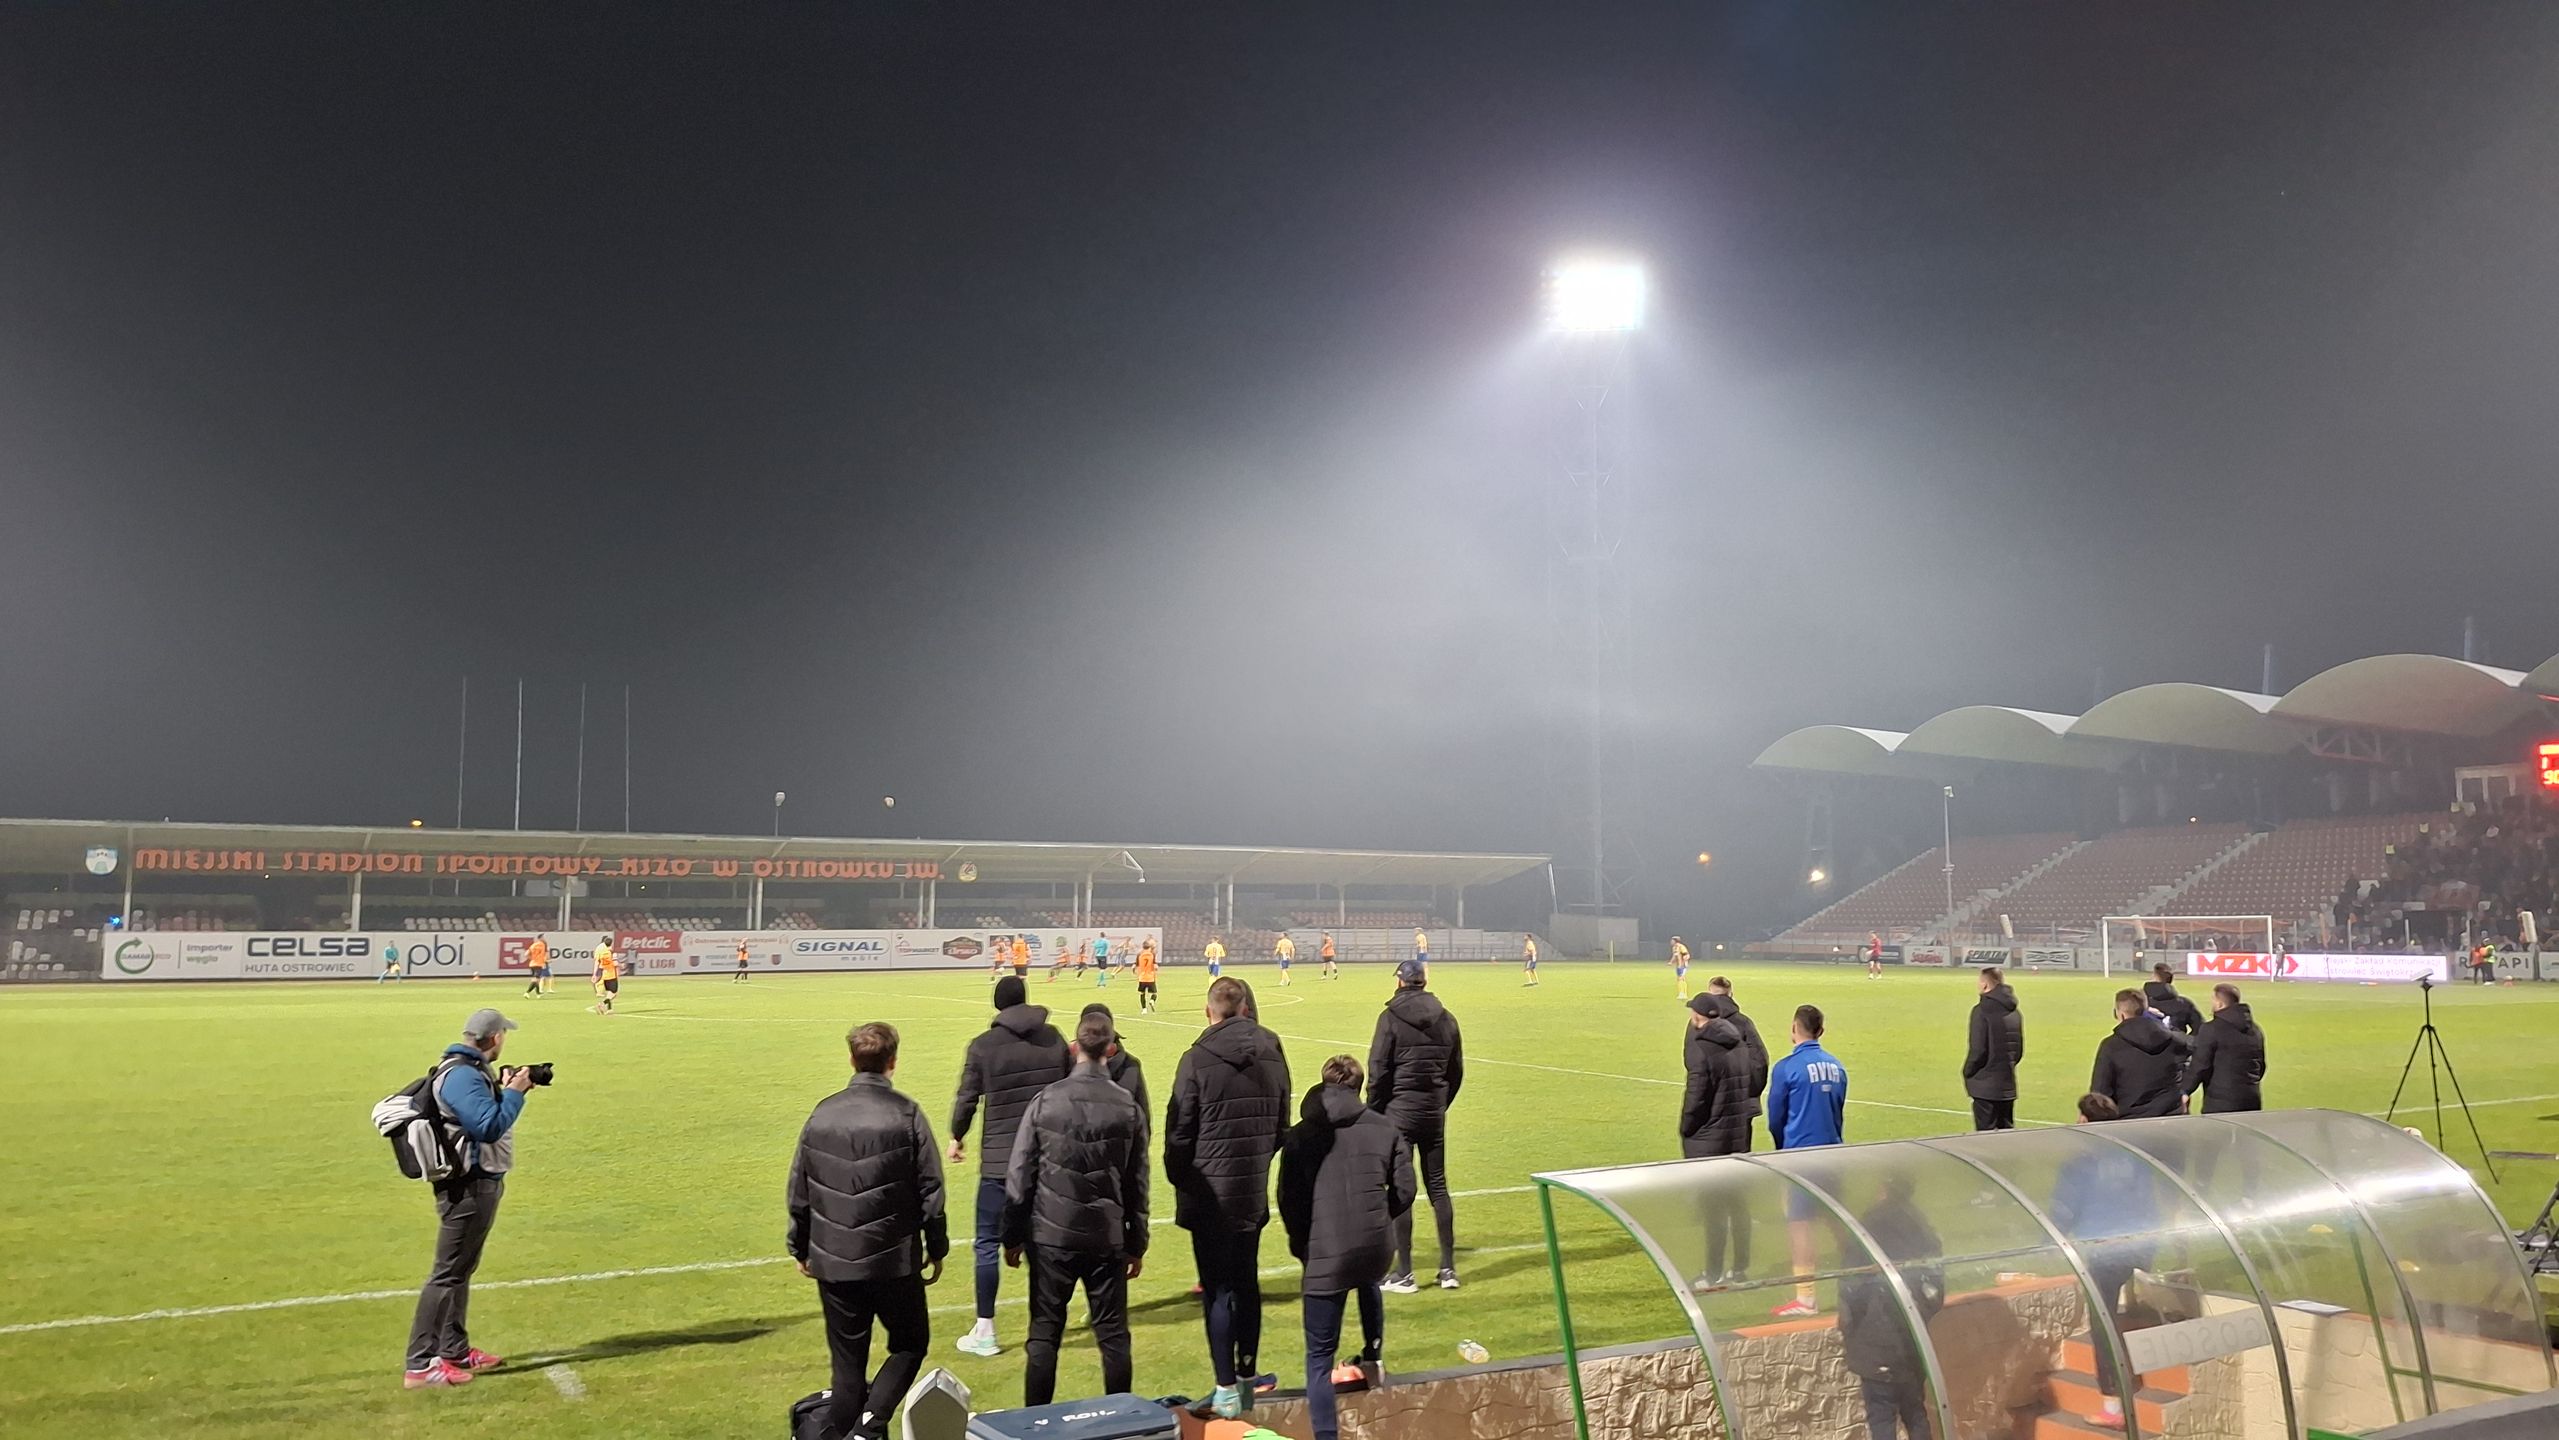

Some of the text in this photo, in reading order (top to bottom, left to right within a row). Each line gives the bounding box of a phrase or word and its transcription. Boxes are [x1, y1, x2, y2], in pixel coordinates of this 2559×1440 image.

[135, 849, 265, 870] MIEJSKI
[282, 851, 423, 873] STADION
[437, 855, 601, 875] SPORTOWY
[712, 860, 738, 877] W
[753, 859, 895, 878] OSTROWCU
[621, 935, 672, 949] Betclic
[796, 941, 884, 951] SIGNAL
[407, 934, 464, 974] pbi
[245, 963, 355, 973] HUTA OSTROWIEC
[638, 959, 645, 968] 3
[1807, 1062, 1840, 1083] AVIA
